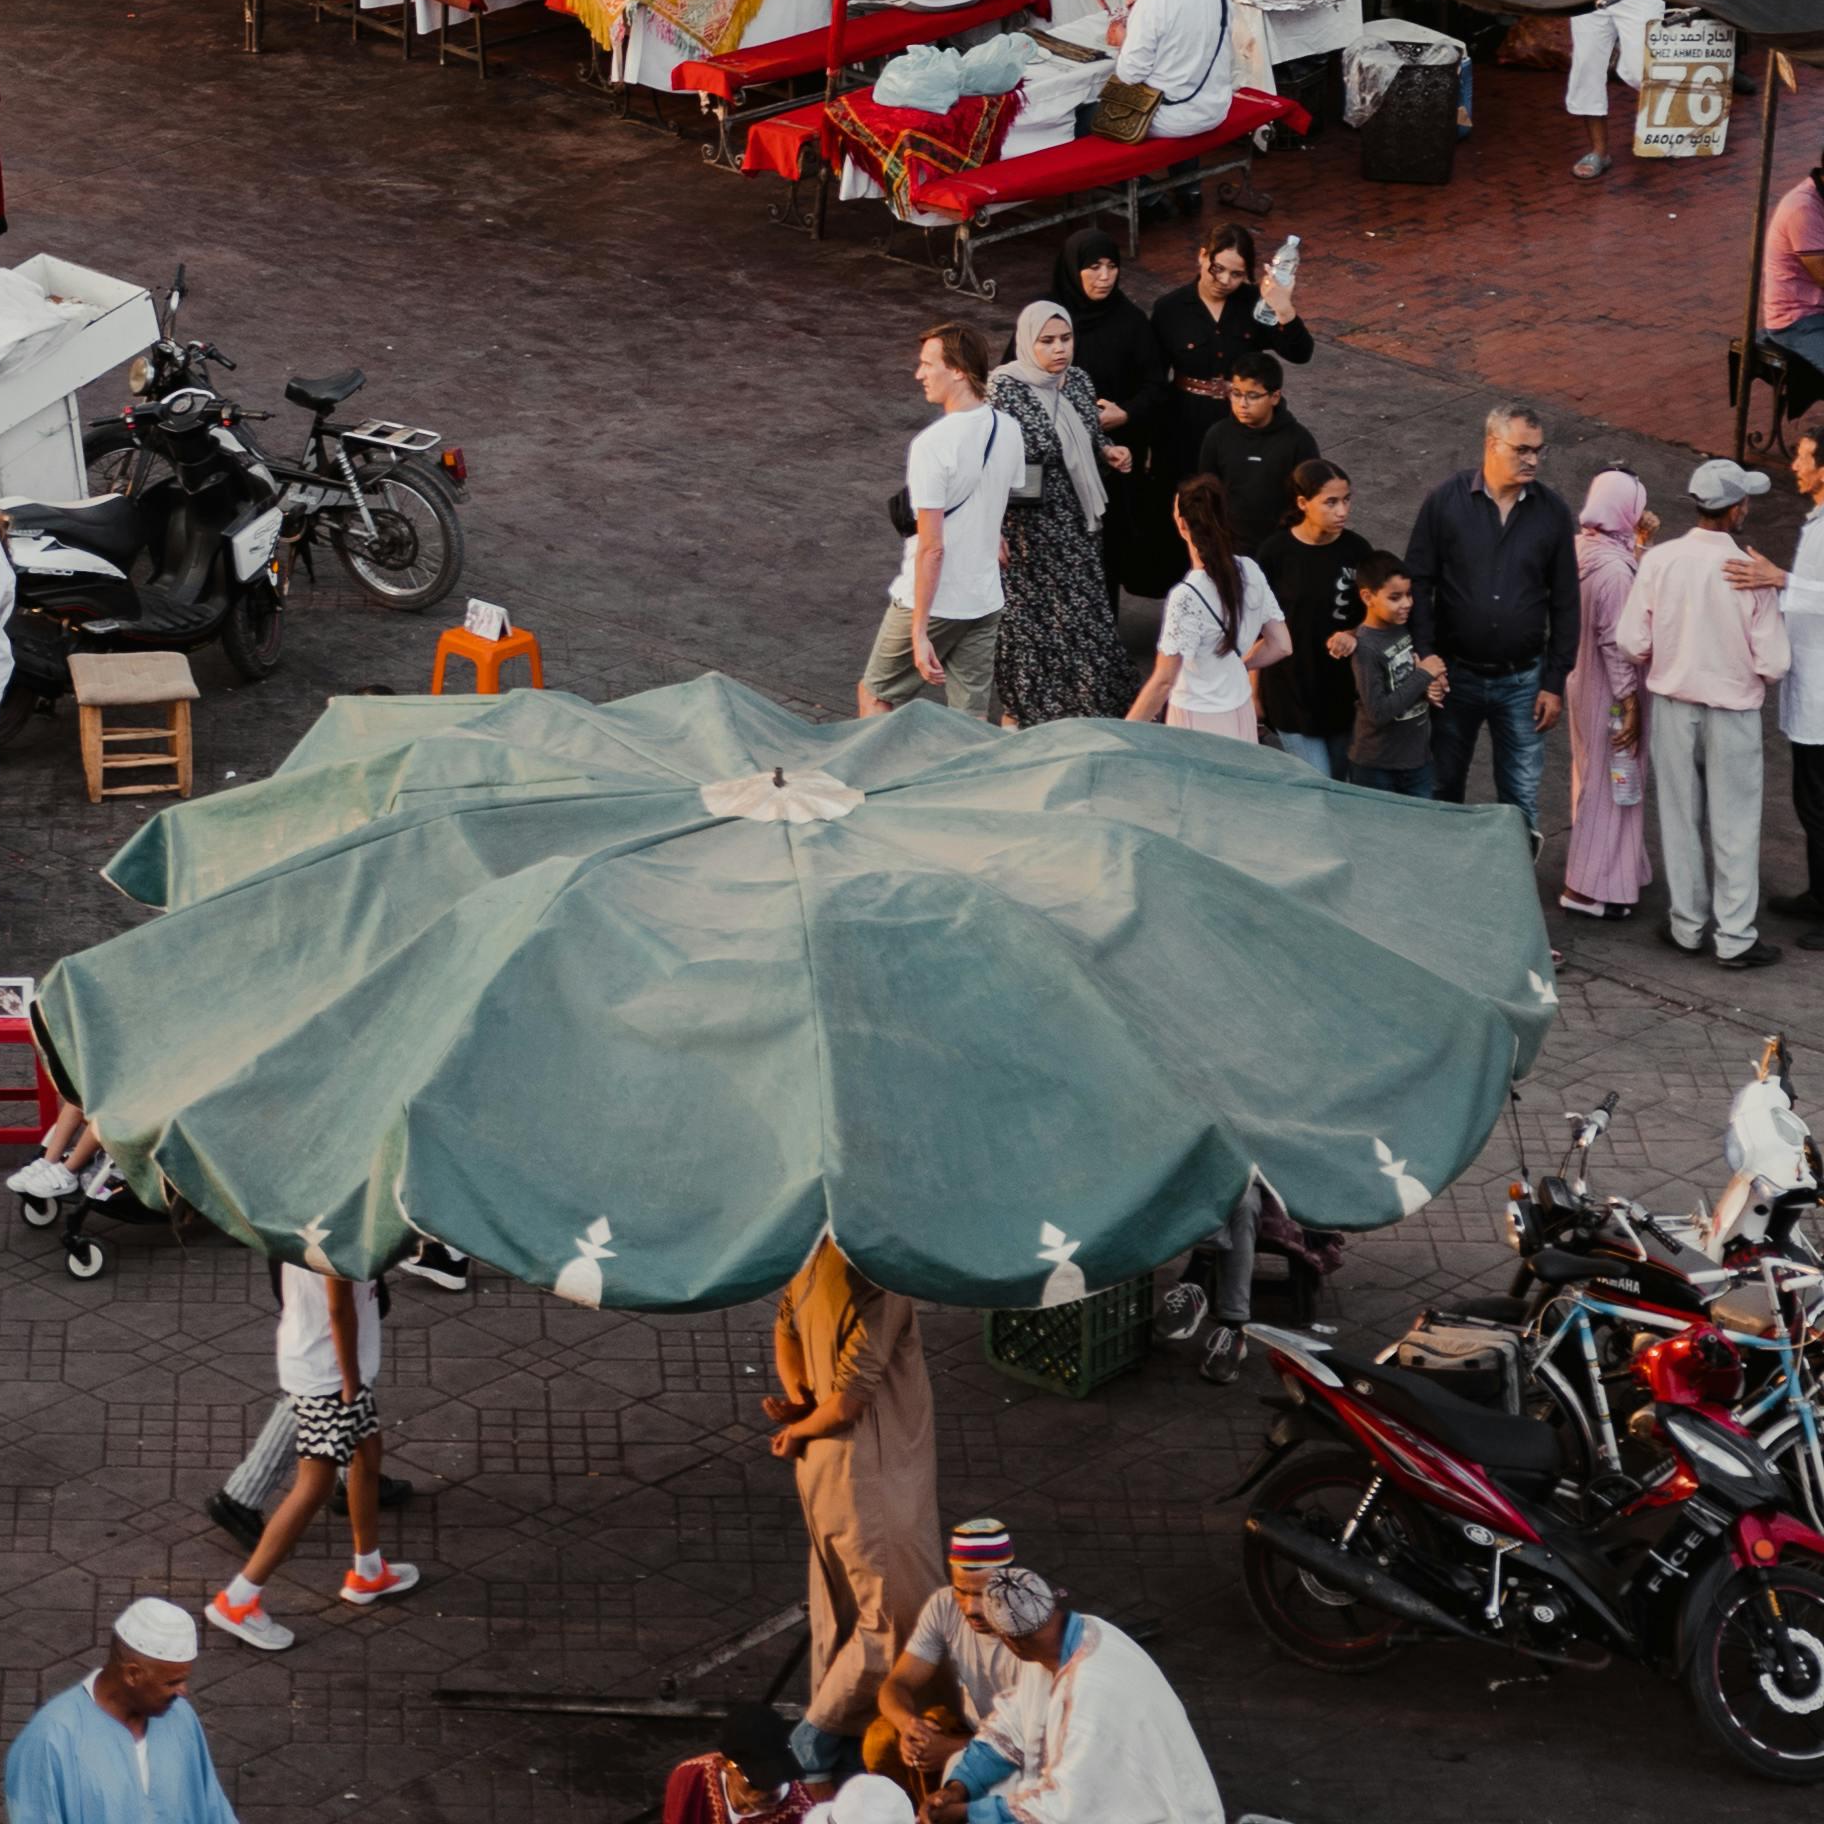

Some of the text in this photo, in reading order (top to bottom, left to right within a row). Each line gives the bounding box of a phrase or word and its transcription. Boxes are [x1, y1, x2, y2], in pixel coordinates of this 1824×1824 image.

[1679, 26, 1706, 42] أحمد
[1707, 29, 1735, 45] الحاج
[1651, 47, 1733, 59] CHEZ AHMED BAOLO
[1650, 64, 1725, 127] 76
[1643, 133, 1685, 146] BAOLO
[1689, 132, 1722, 149] باولو
